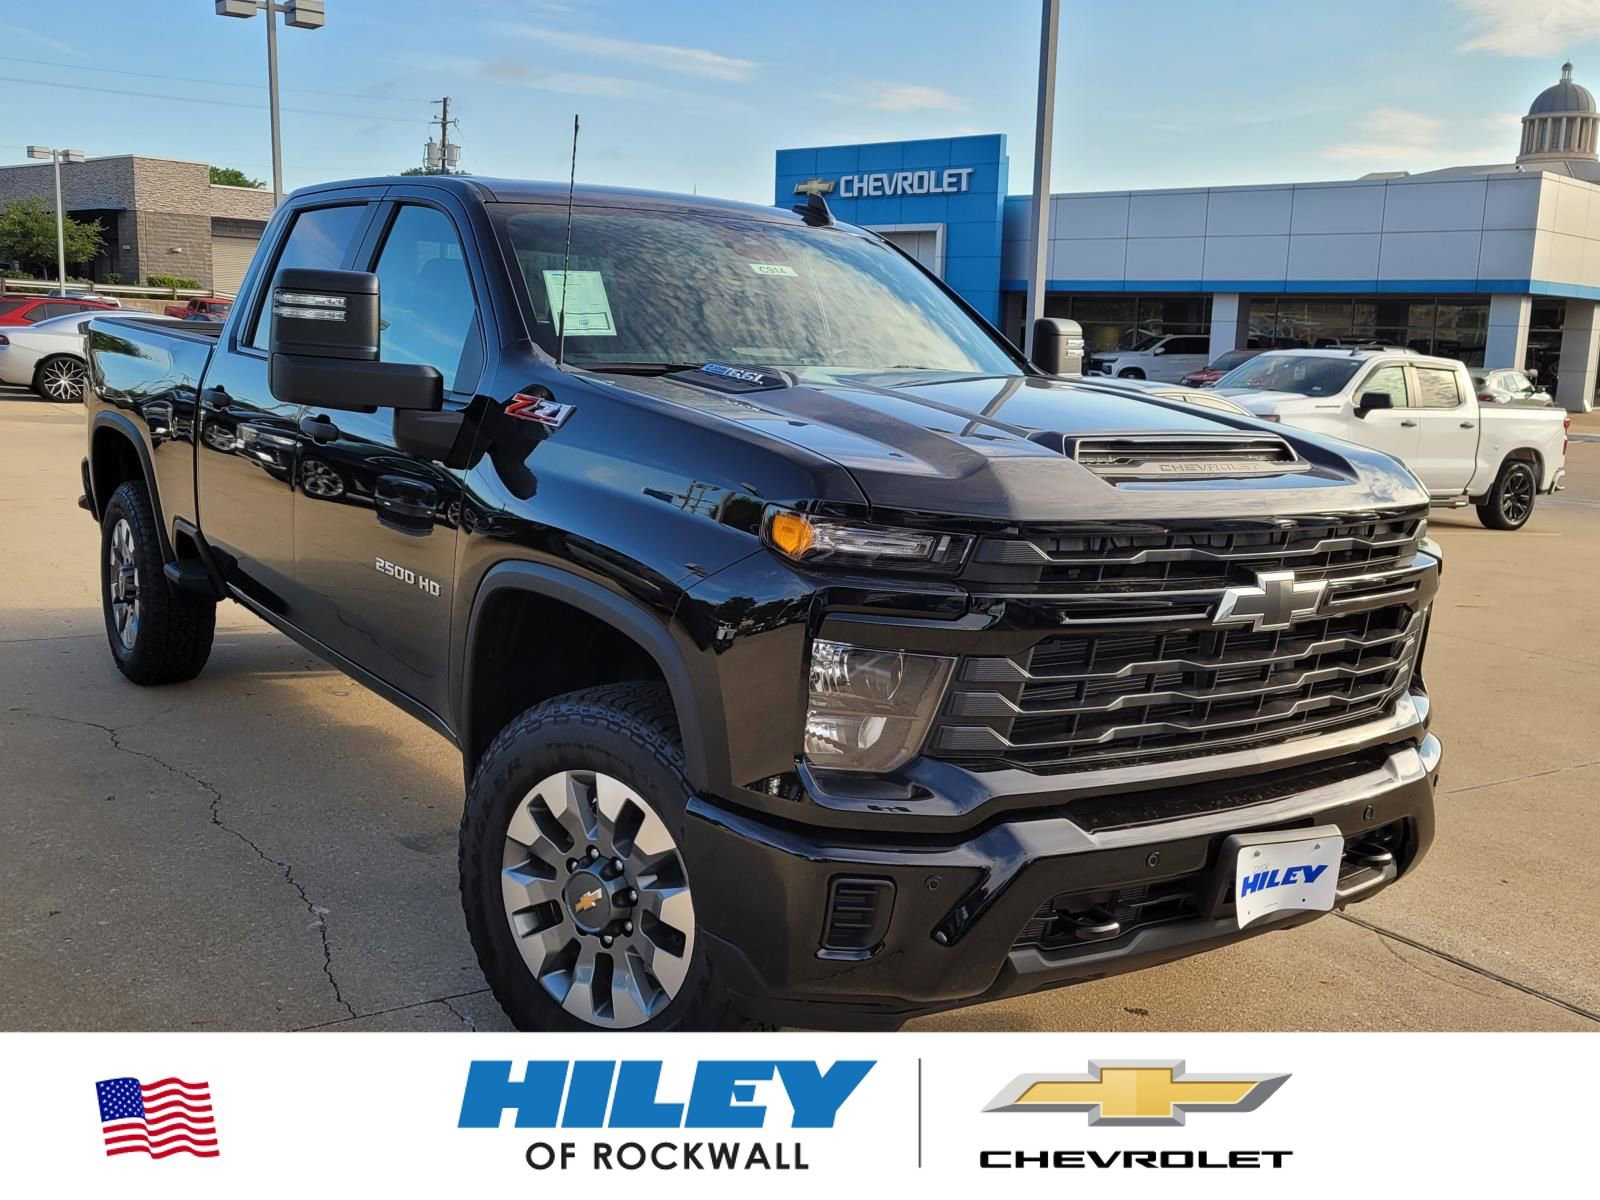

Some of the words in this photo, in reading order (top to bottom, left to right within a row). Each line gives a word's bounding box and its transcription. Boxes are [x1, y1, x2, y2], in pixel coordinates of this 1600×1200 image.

[840, 168, 974, 198] CHEVROLET
[504, 392, 576, 428] Z71
[1159, 462, 1260, 473] CHEVROLET
[375, 556, 416, 585] 2500
[418, 575, 441, 597] HD
[1240, 864, 1328, 898] HILEY
